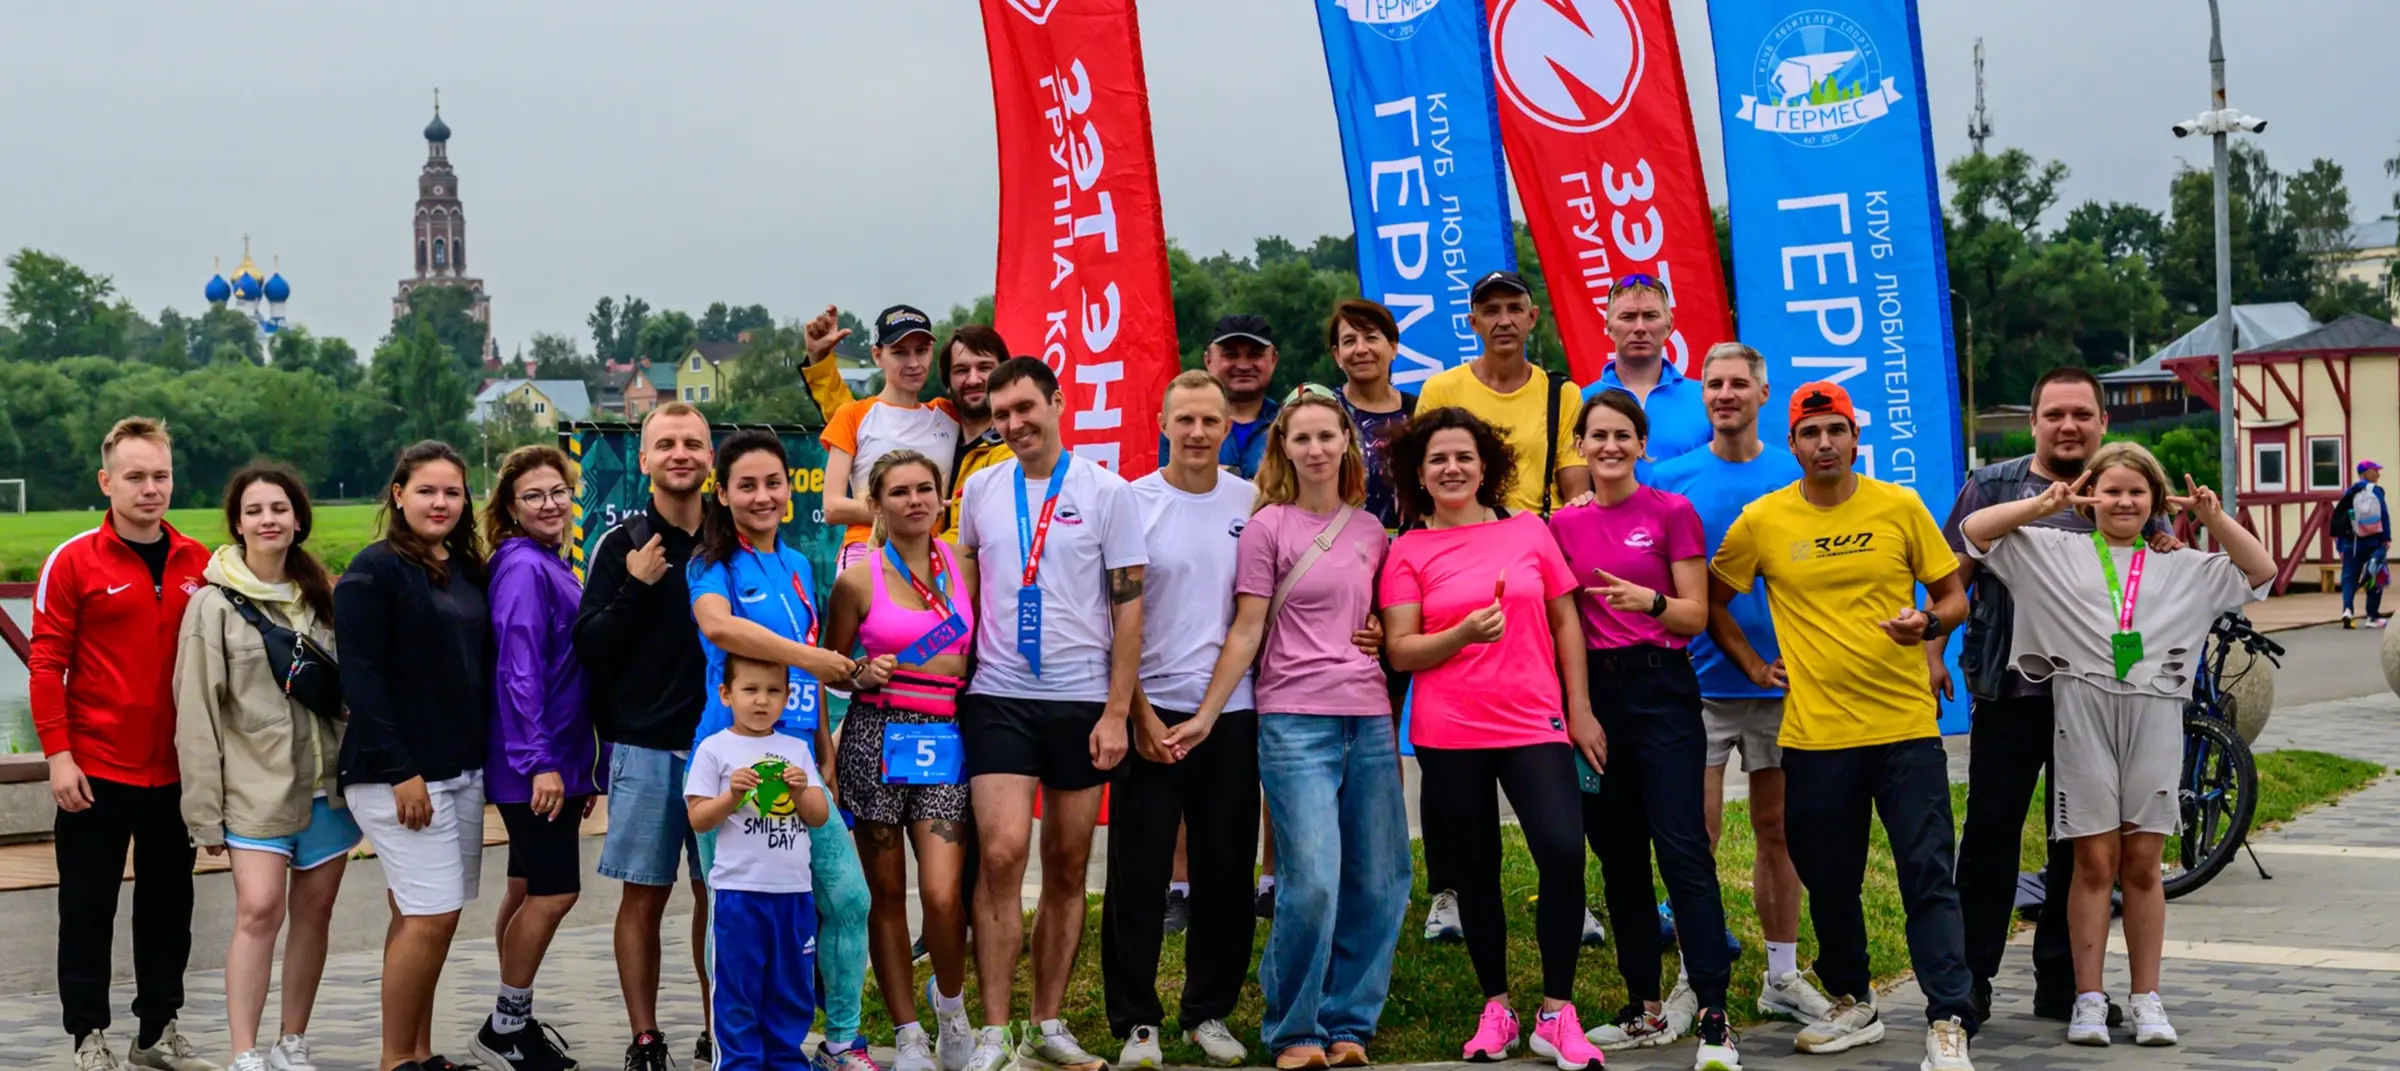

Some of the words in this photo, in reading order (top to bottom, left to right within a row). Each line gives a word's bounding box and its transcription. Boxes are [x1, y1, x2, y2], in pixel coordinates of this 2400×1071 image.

[1840, 21, 1873, 57] СПОРТА
[1426, 93, 1454, 177] КЛУБ
[1775, 98, 1869, 130] ГЕРМЕС
[1039, 75, 1075, 290] ГРУППА
[1055, 57, 1119, 253] ЗЭТ
[1371, 96, 1444, 385] ГЕРМ
[1560, 171, 1613, 335] ГРУПП
[1865, 191, 1893, 259] КЛУБ
[1042, 310, 1068, 378] КО
[1874, 272, 1917, 440] ЛЮБИТЕЛЕЙ
[1892, 448, 1917, 485] СП
[605, 504, 617, 526] 5
[915, 739, 937, 767] 5
[744, 817, 788, 834] SMILE
[790, 816, 807, 834] AL
[768, 833, 796, 851] DAY
